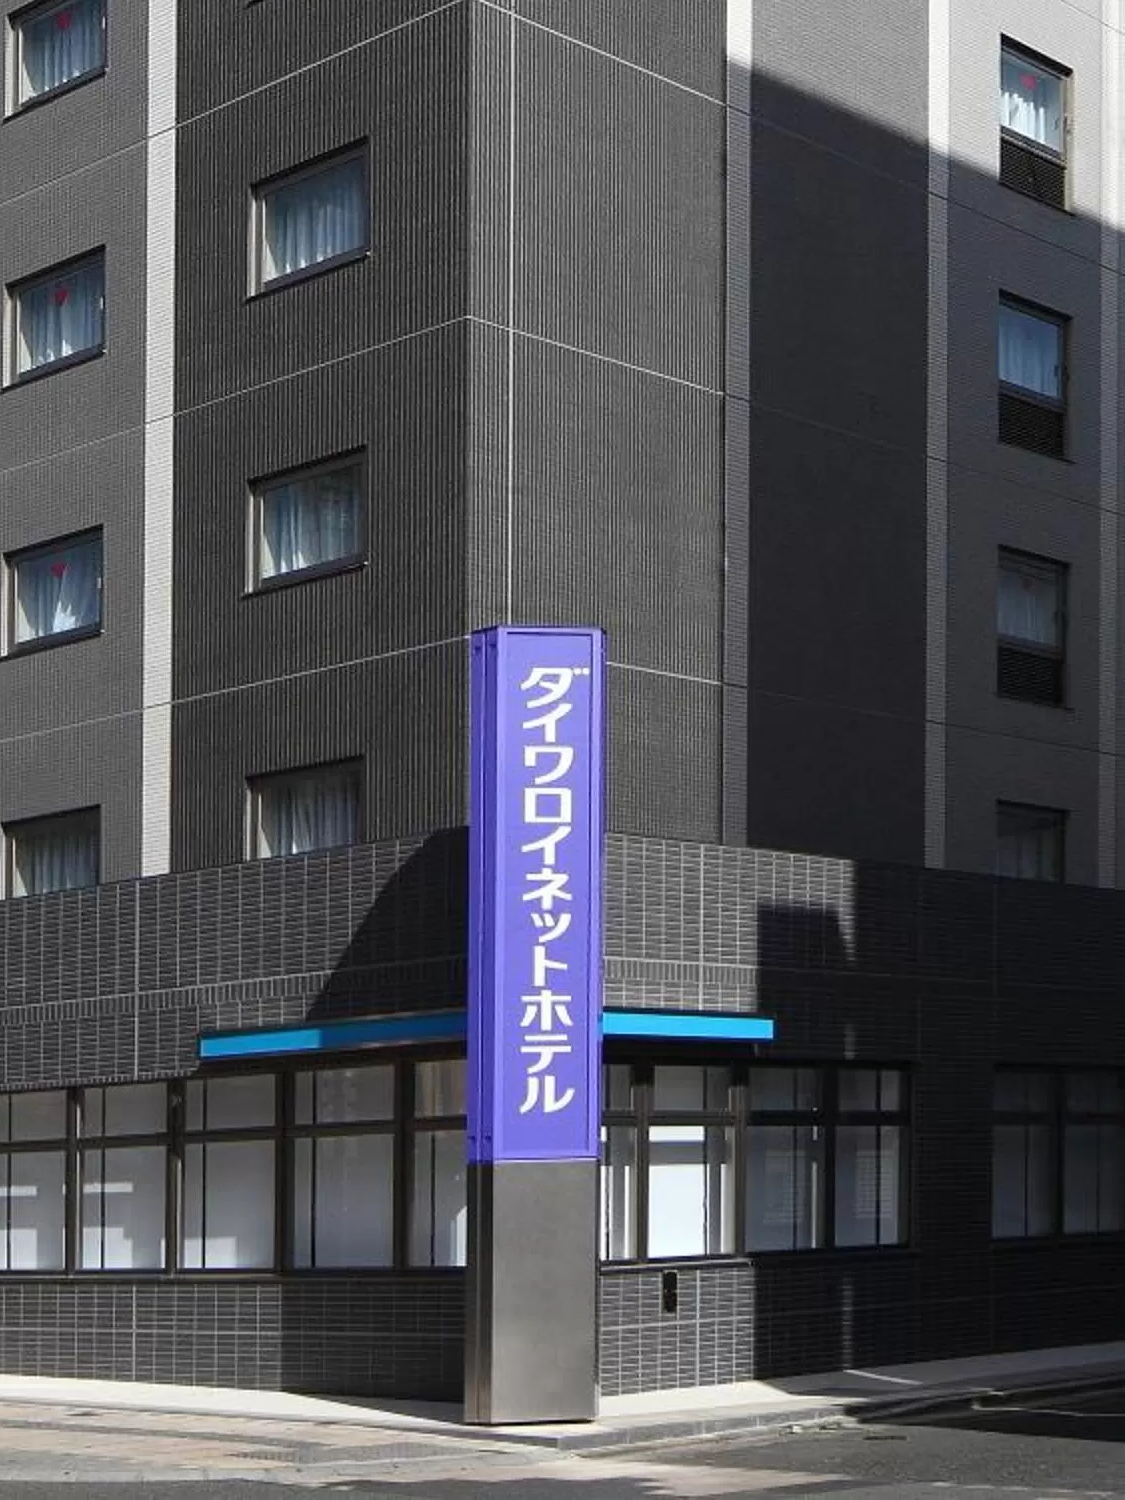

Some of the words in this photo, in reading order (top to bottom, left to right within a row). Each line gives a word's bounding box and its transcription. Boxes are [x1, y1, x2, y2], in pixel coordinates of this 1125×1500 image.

[519, 666, 590, 1114] ダイワロイネットホテル
